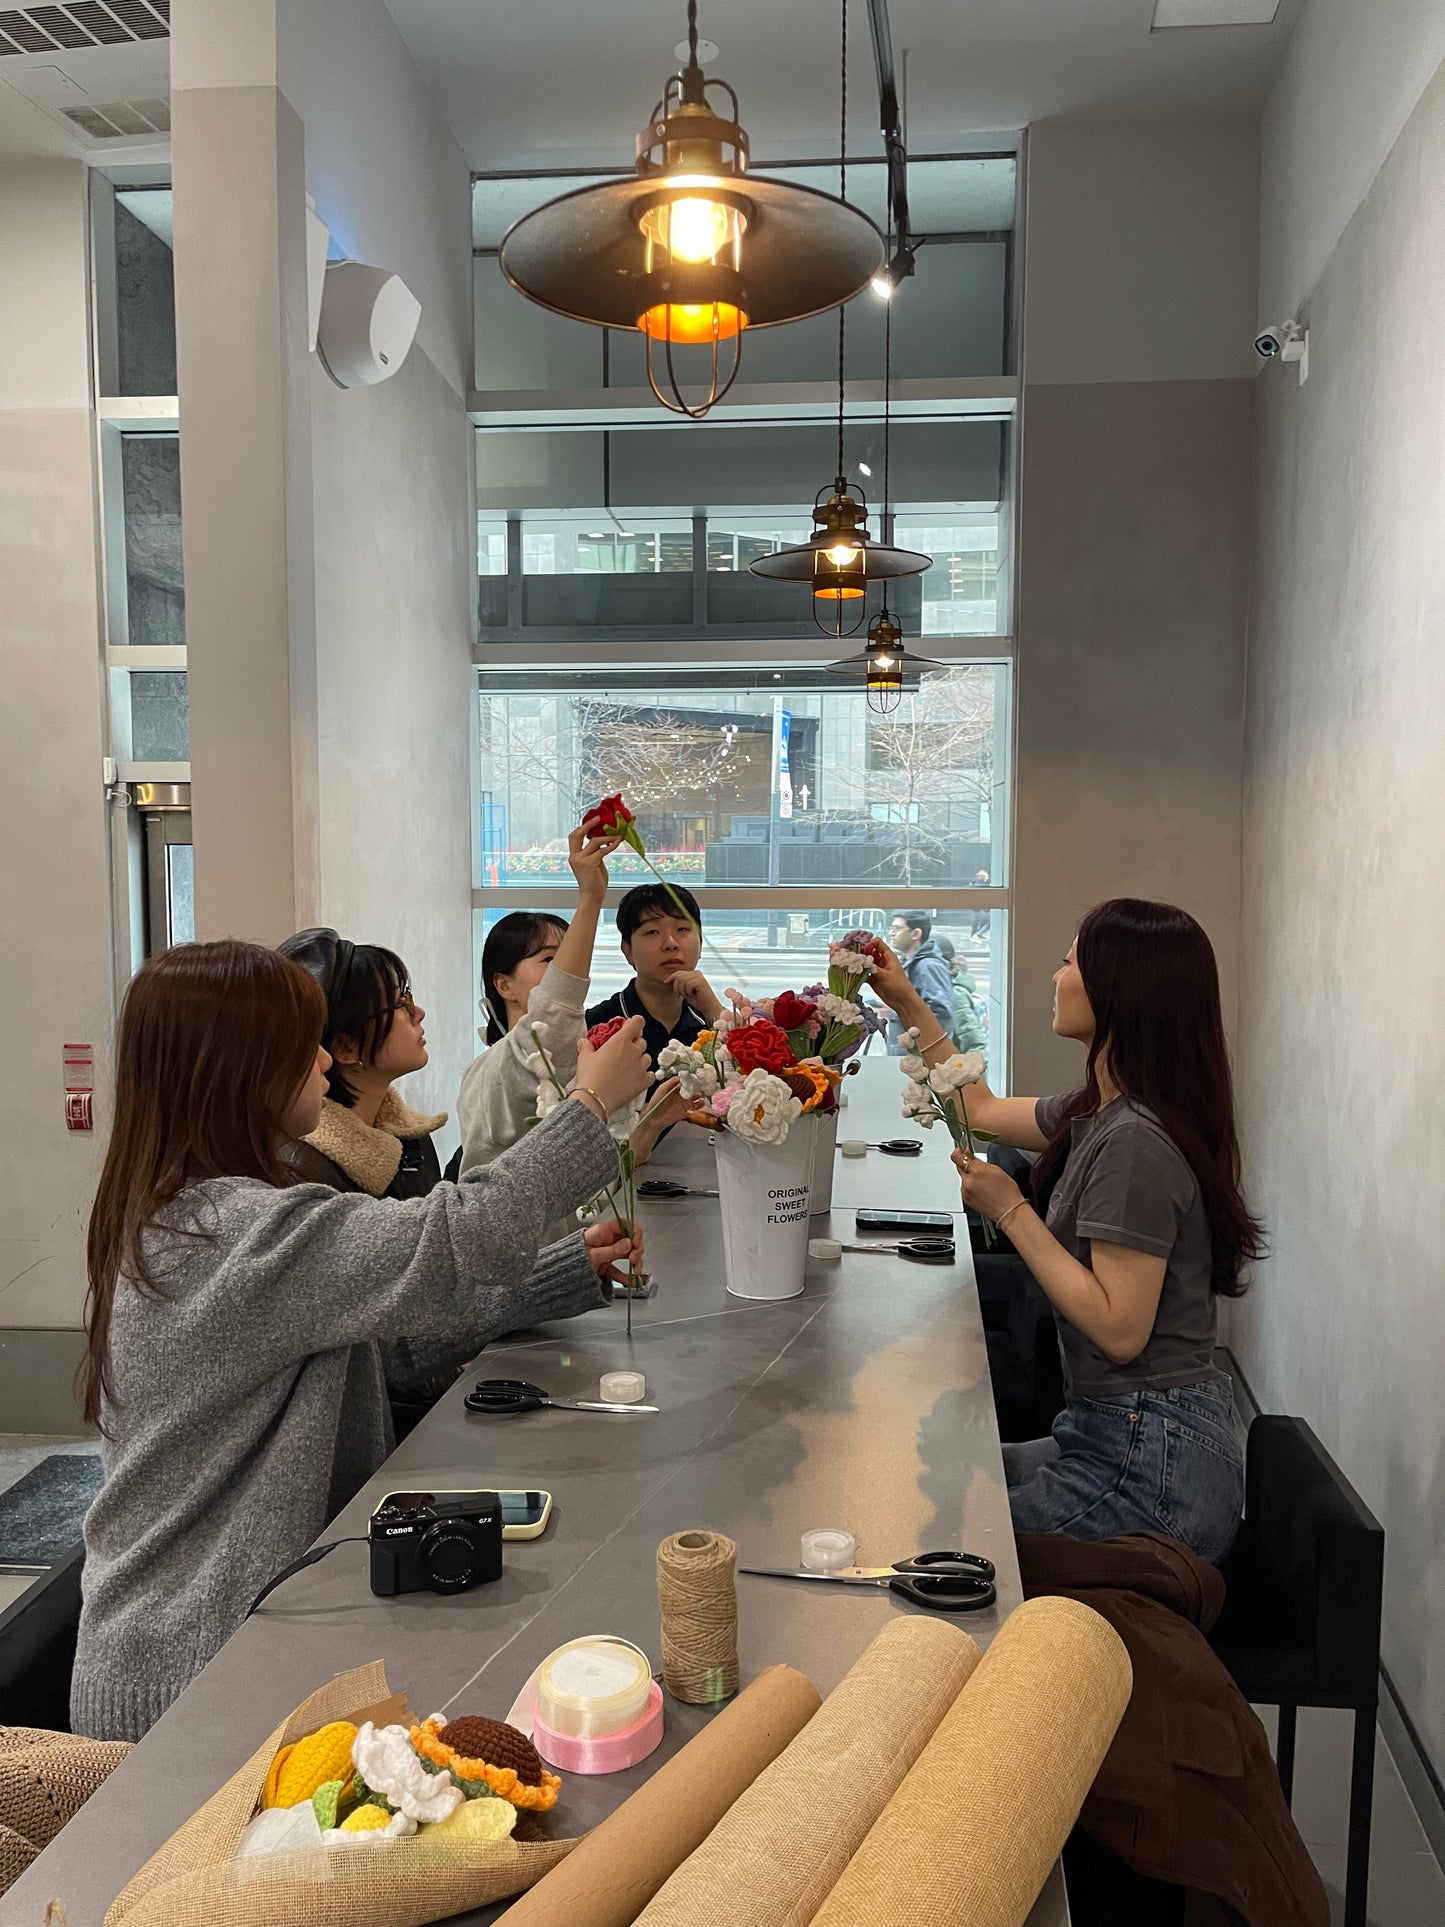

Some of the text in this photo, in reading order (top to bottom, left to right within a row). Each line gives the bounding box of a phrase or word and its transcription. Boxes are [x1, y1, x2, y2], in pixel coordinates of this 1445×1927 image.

[768, 1185, 809, 1199] ORIGINAL
[775, 1198, 806, 1211] SWEET
[767, 1209, 809, 1224] FLOWERS
[386, 1526, 414, 1536] Canon
